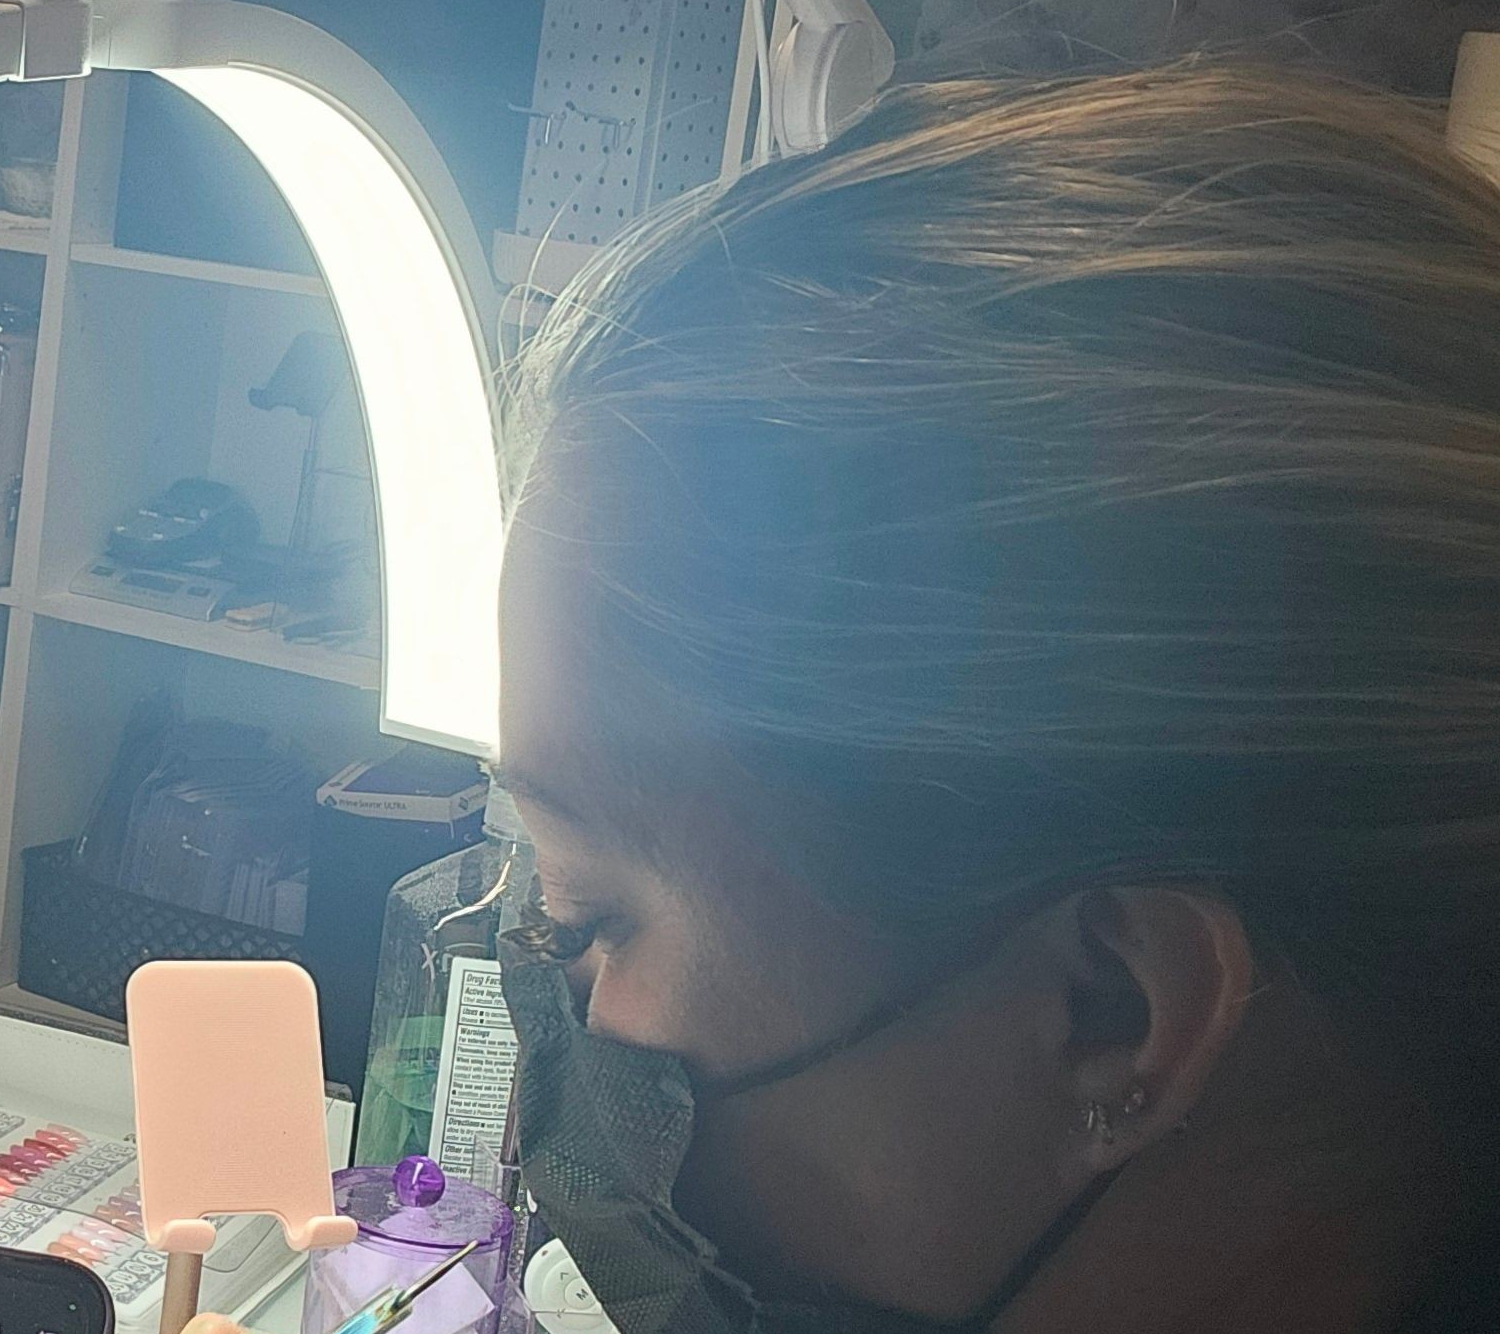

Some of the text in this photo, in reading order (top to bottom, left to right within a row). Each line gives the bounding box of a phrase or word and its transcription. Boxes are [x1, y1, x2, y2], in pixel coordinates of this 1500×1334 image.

[466, 973, 501, 986] Drug Fac
[465, 987, 484, 996] Active
[461, 1028, 490, 1038] Warnings
[575, 1287, 590, 1301] M
